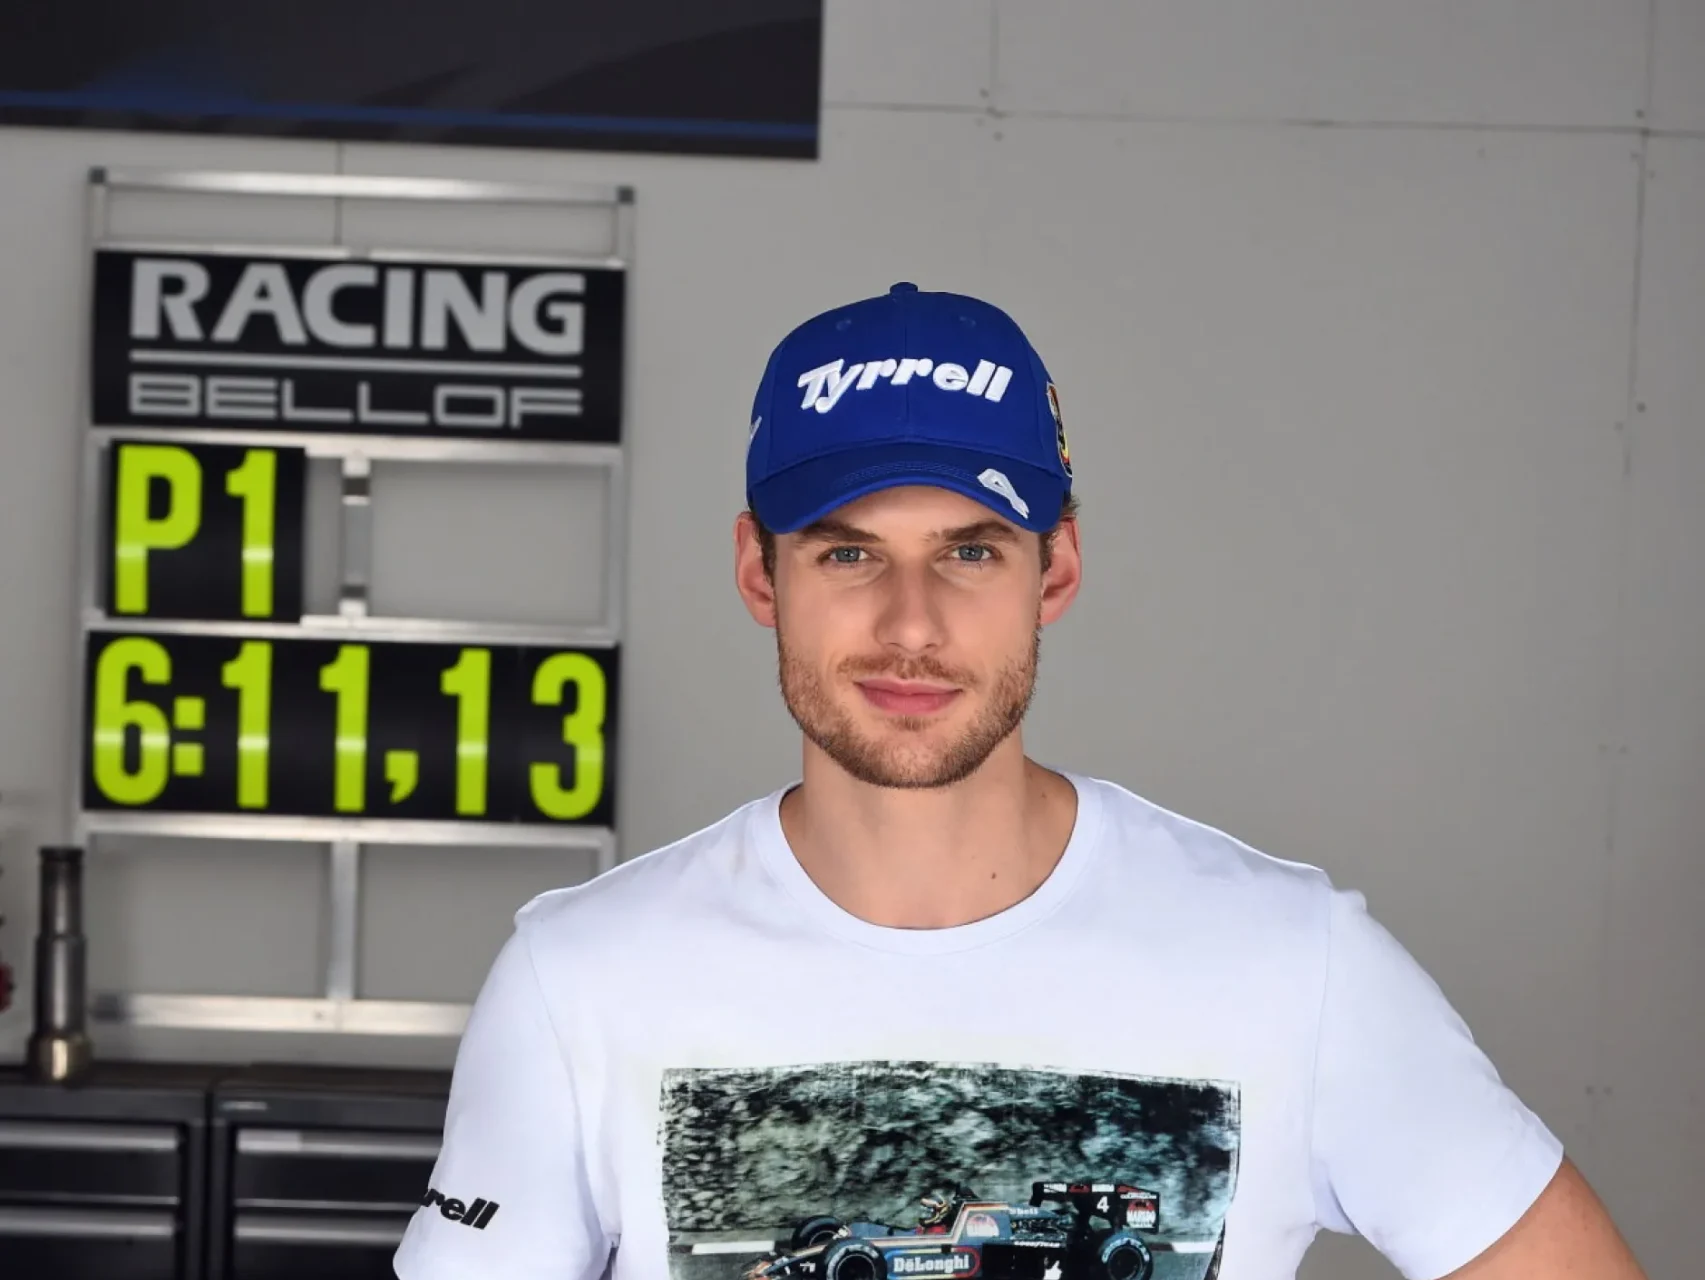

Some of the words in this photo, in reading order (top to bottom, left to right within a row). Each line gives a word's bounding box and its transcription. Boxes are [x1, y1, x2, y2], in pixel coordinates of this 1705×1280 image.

[129, 257, 586, 356] RACING
[129, 372, 583, 429] BELLOF
[797, 358, 1013, 414] Tyrrell
[115, 444, 276, 617] P1
[420, 1188, 500, 1230] rell
[1096, 1196, 1110, 1213] 4
